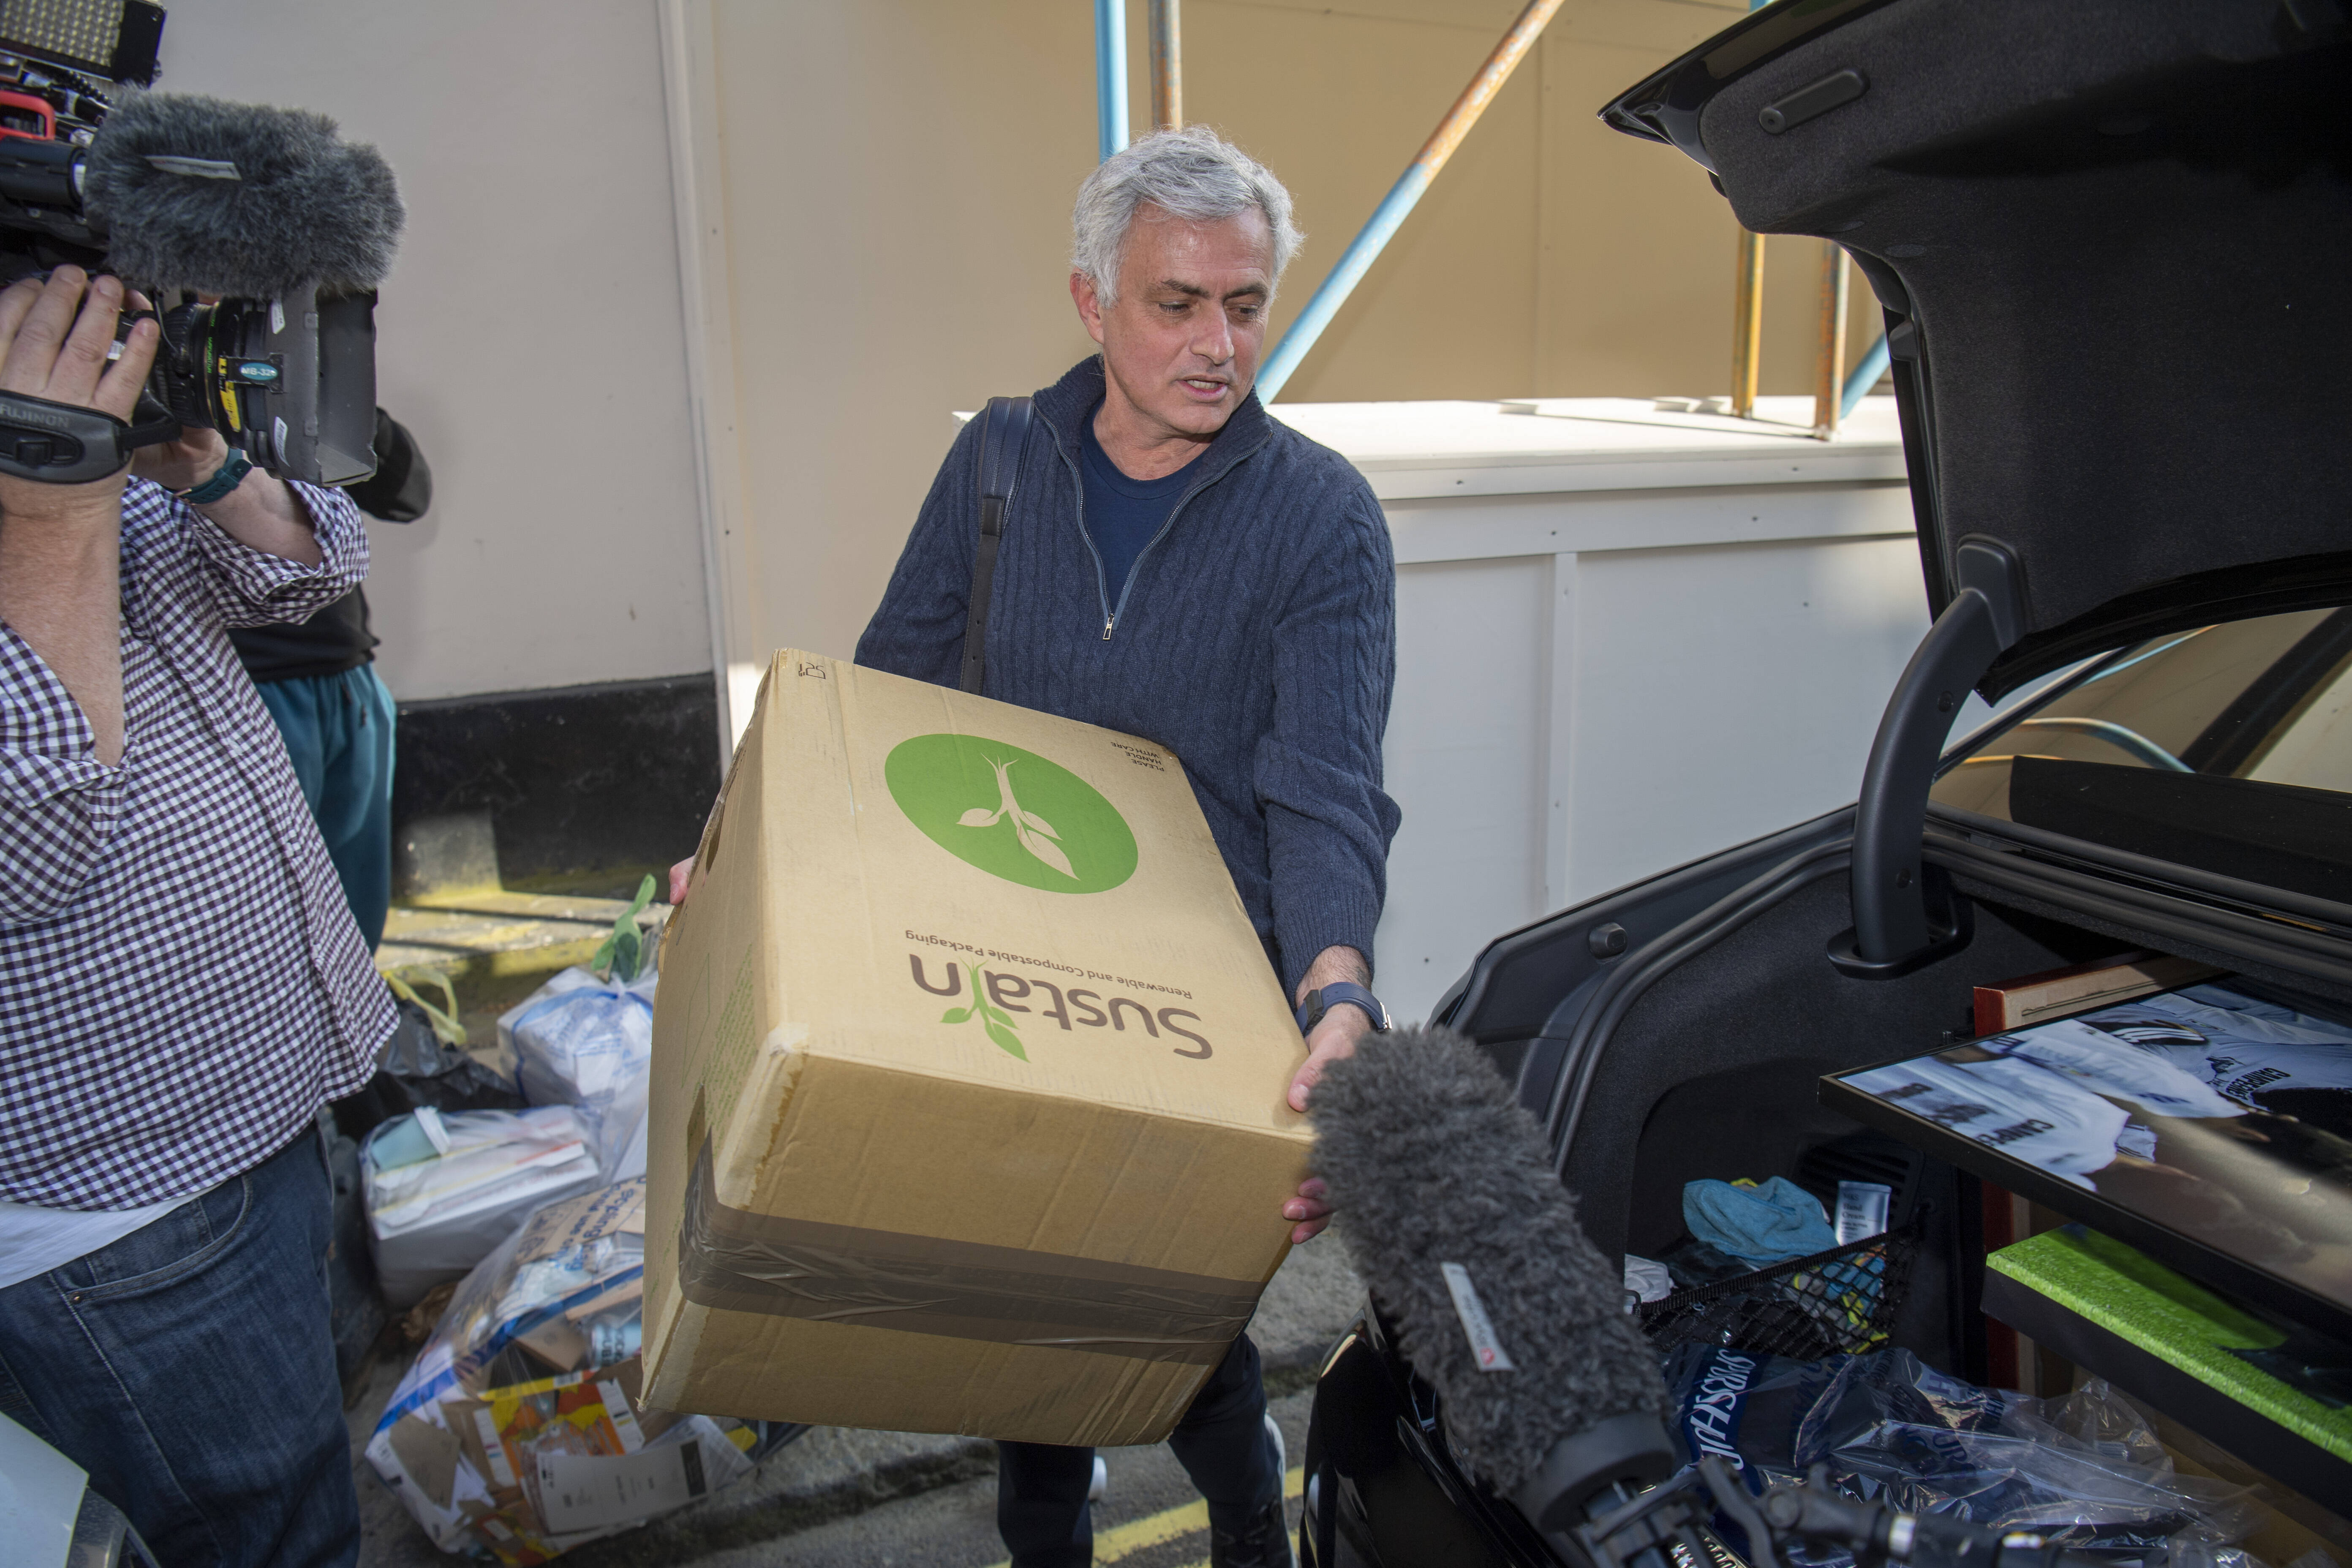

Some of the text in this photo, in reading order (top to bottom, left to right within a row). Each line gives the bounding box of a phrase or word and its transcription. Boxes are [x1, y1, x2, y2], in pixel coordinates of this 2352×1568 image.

[0, 403, 69, 428] FUJINON
[1110, 742, 1160, 759] WITH CARE
[1124, 751, 1162, 765] HANDLE
[1131, 759, 1165, 772] PLEASE
[905, 930, 1193, 999] Renewable and Compostable Packaging
